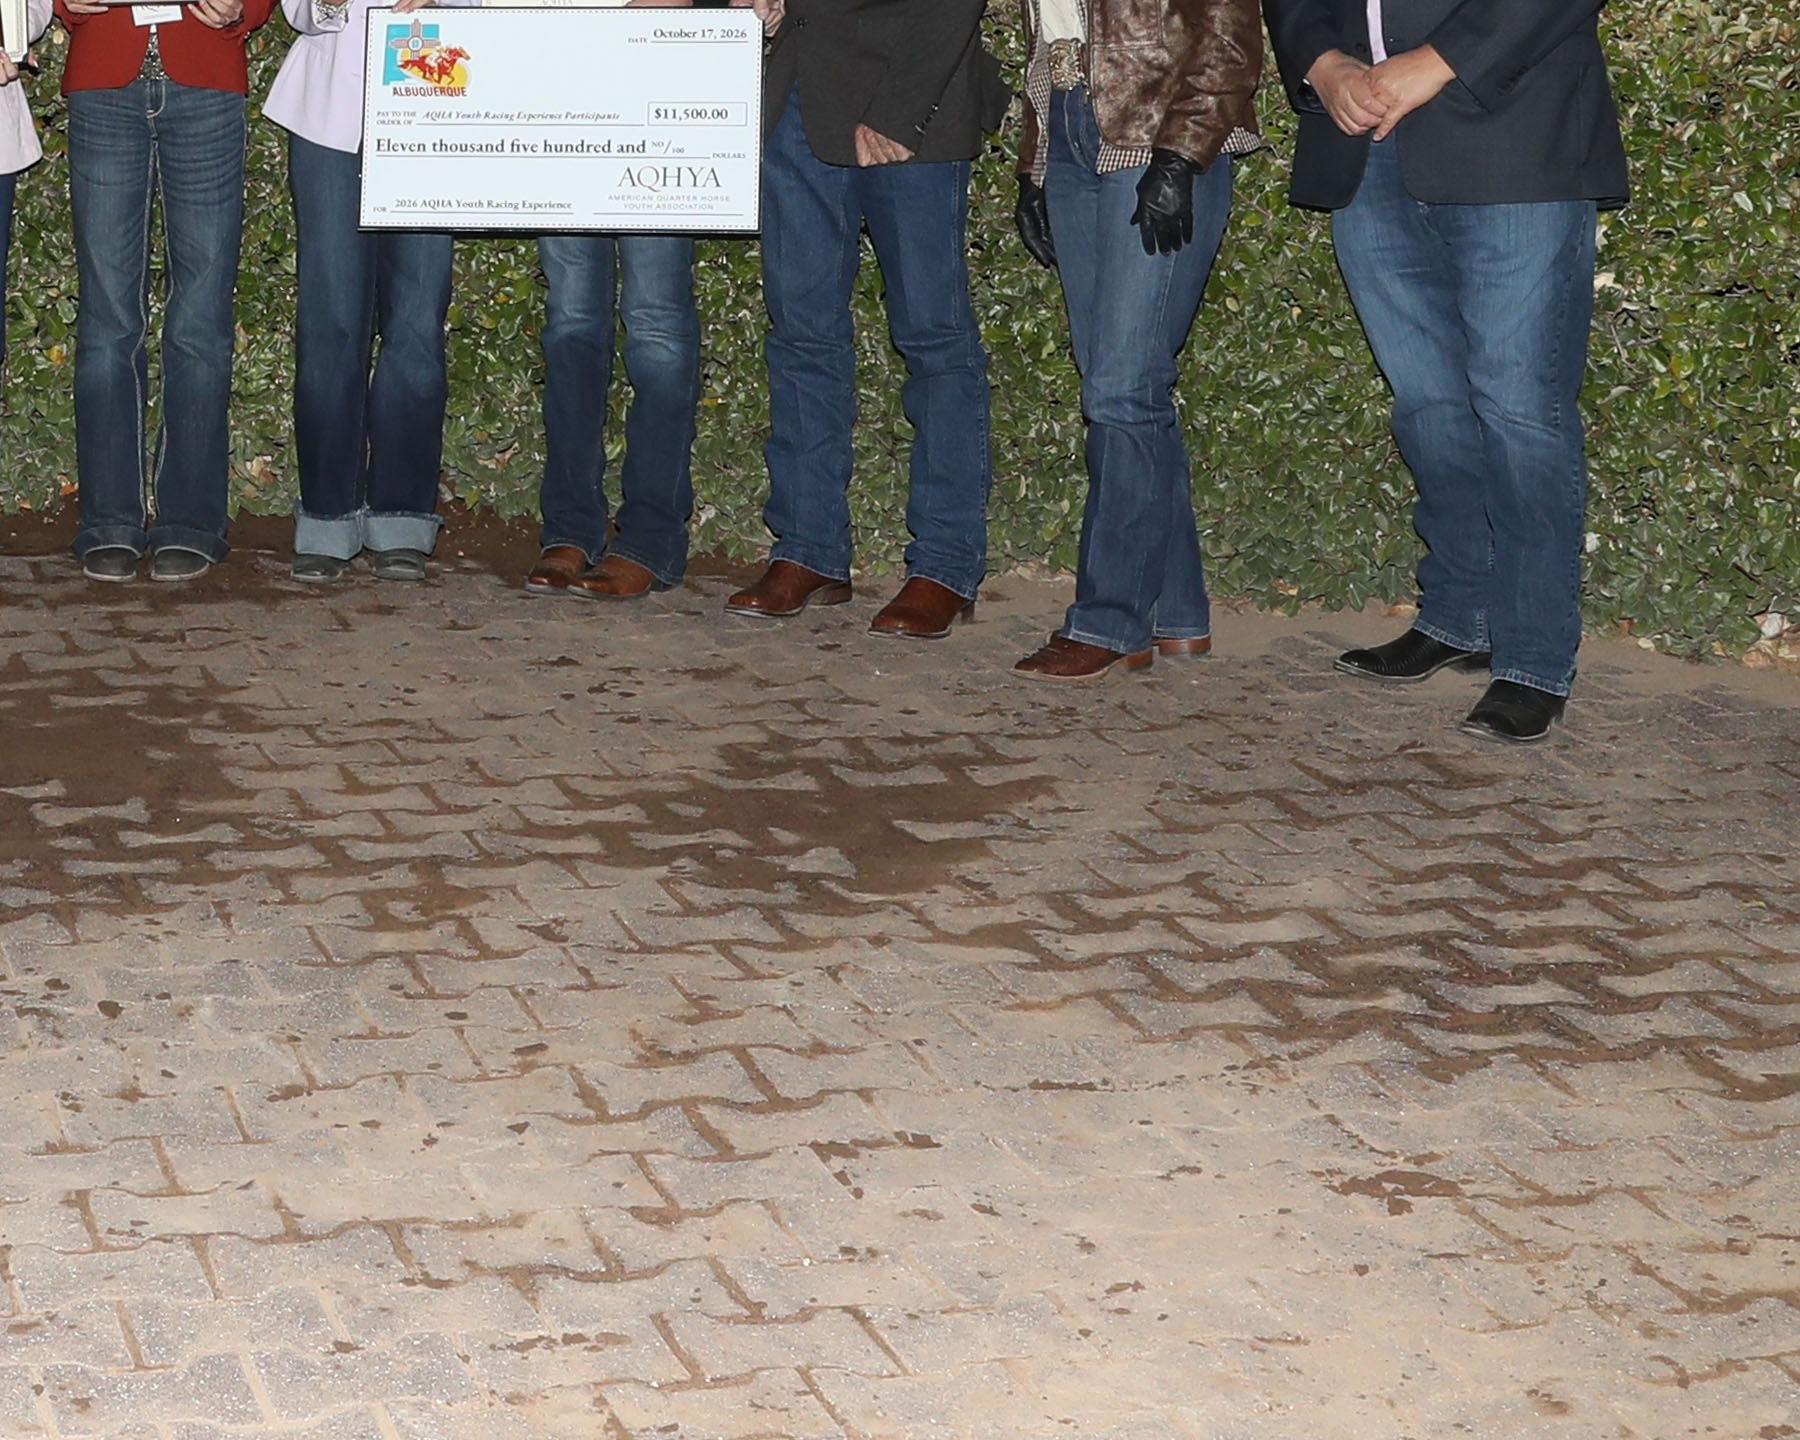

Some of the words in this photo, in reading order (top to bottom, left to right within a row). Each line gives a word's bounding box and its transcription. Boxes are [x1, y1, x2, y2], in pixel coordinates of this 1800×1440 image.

[653, 28, 697, 39] October
[701, 28, 717, 40] 17,
[720, 28, 748, 39] 2026
[392, 86, 468, 97] ALBUQUERQUE
[422, 111, 454, 122] AQHA
[454, 111, 482, 120] Youth
[484, 111, 515, 122] Racing
[516, 111, 562, 122] Experience
[563, 111, 621, 122] Participants
[653, 107, 729, 122] $11,500.00
[376, 138, 426, 153] Eleven
[431, 138, 505, 153] thousand
[510, 139, 539, 153] five
[543, 139, 611, 154] hundred
[616, 139, 646, 154] and
[618, 165, 722, 192] AQHYA
[656, 194, 698, 202] QUARTER
[395, 199, 418, 209] 2026
[420, 199, 453, 210] AQHA
[455, 199, 484, 209] Youth
[486, 200, 520, 211] Racing
[521, 200, 572, 211] Experience
[623, 202, 653, 210] YOUTH
[655, 202, 714, 210] ASSOCIATION
